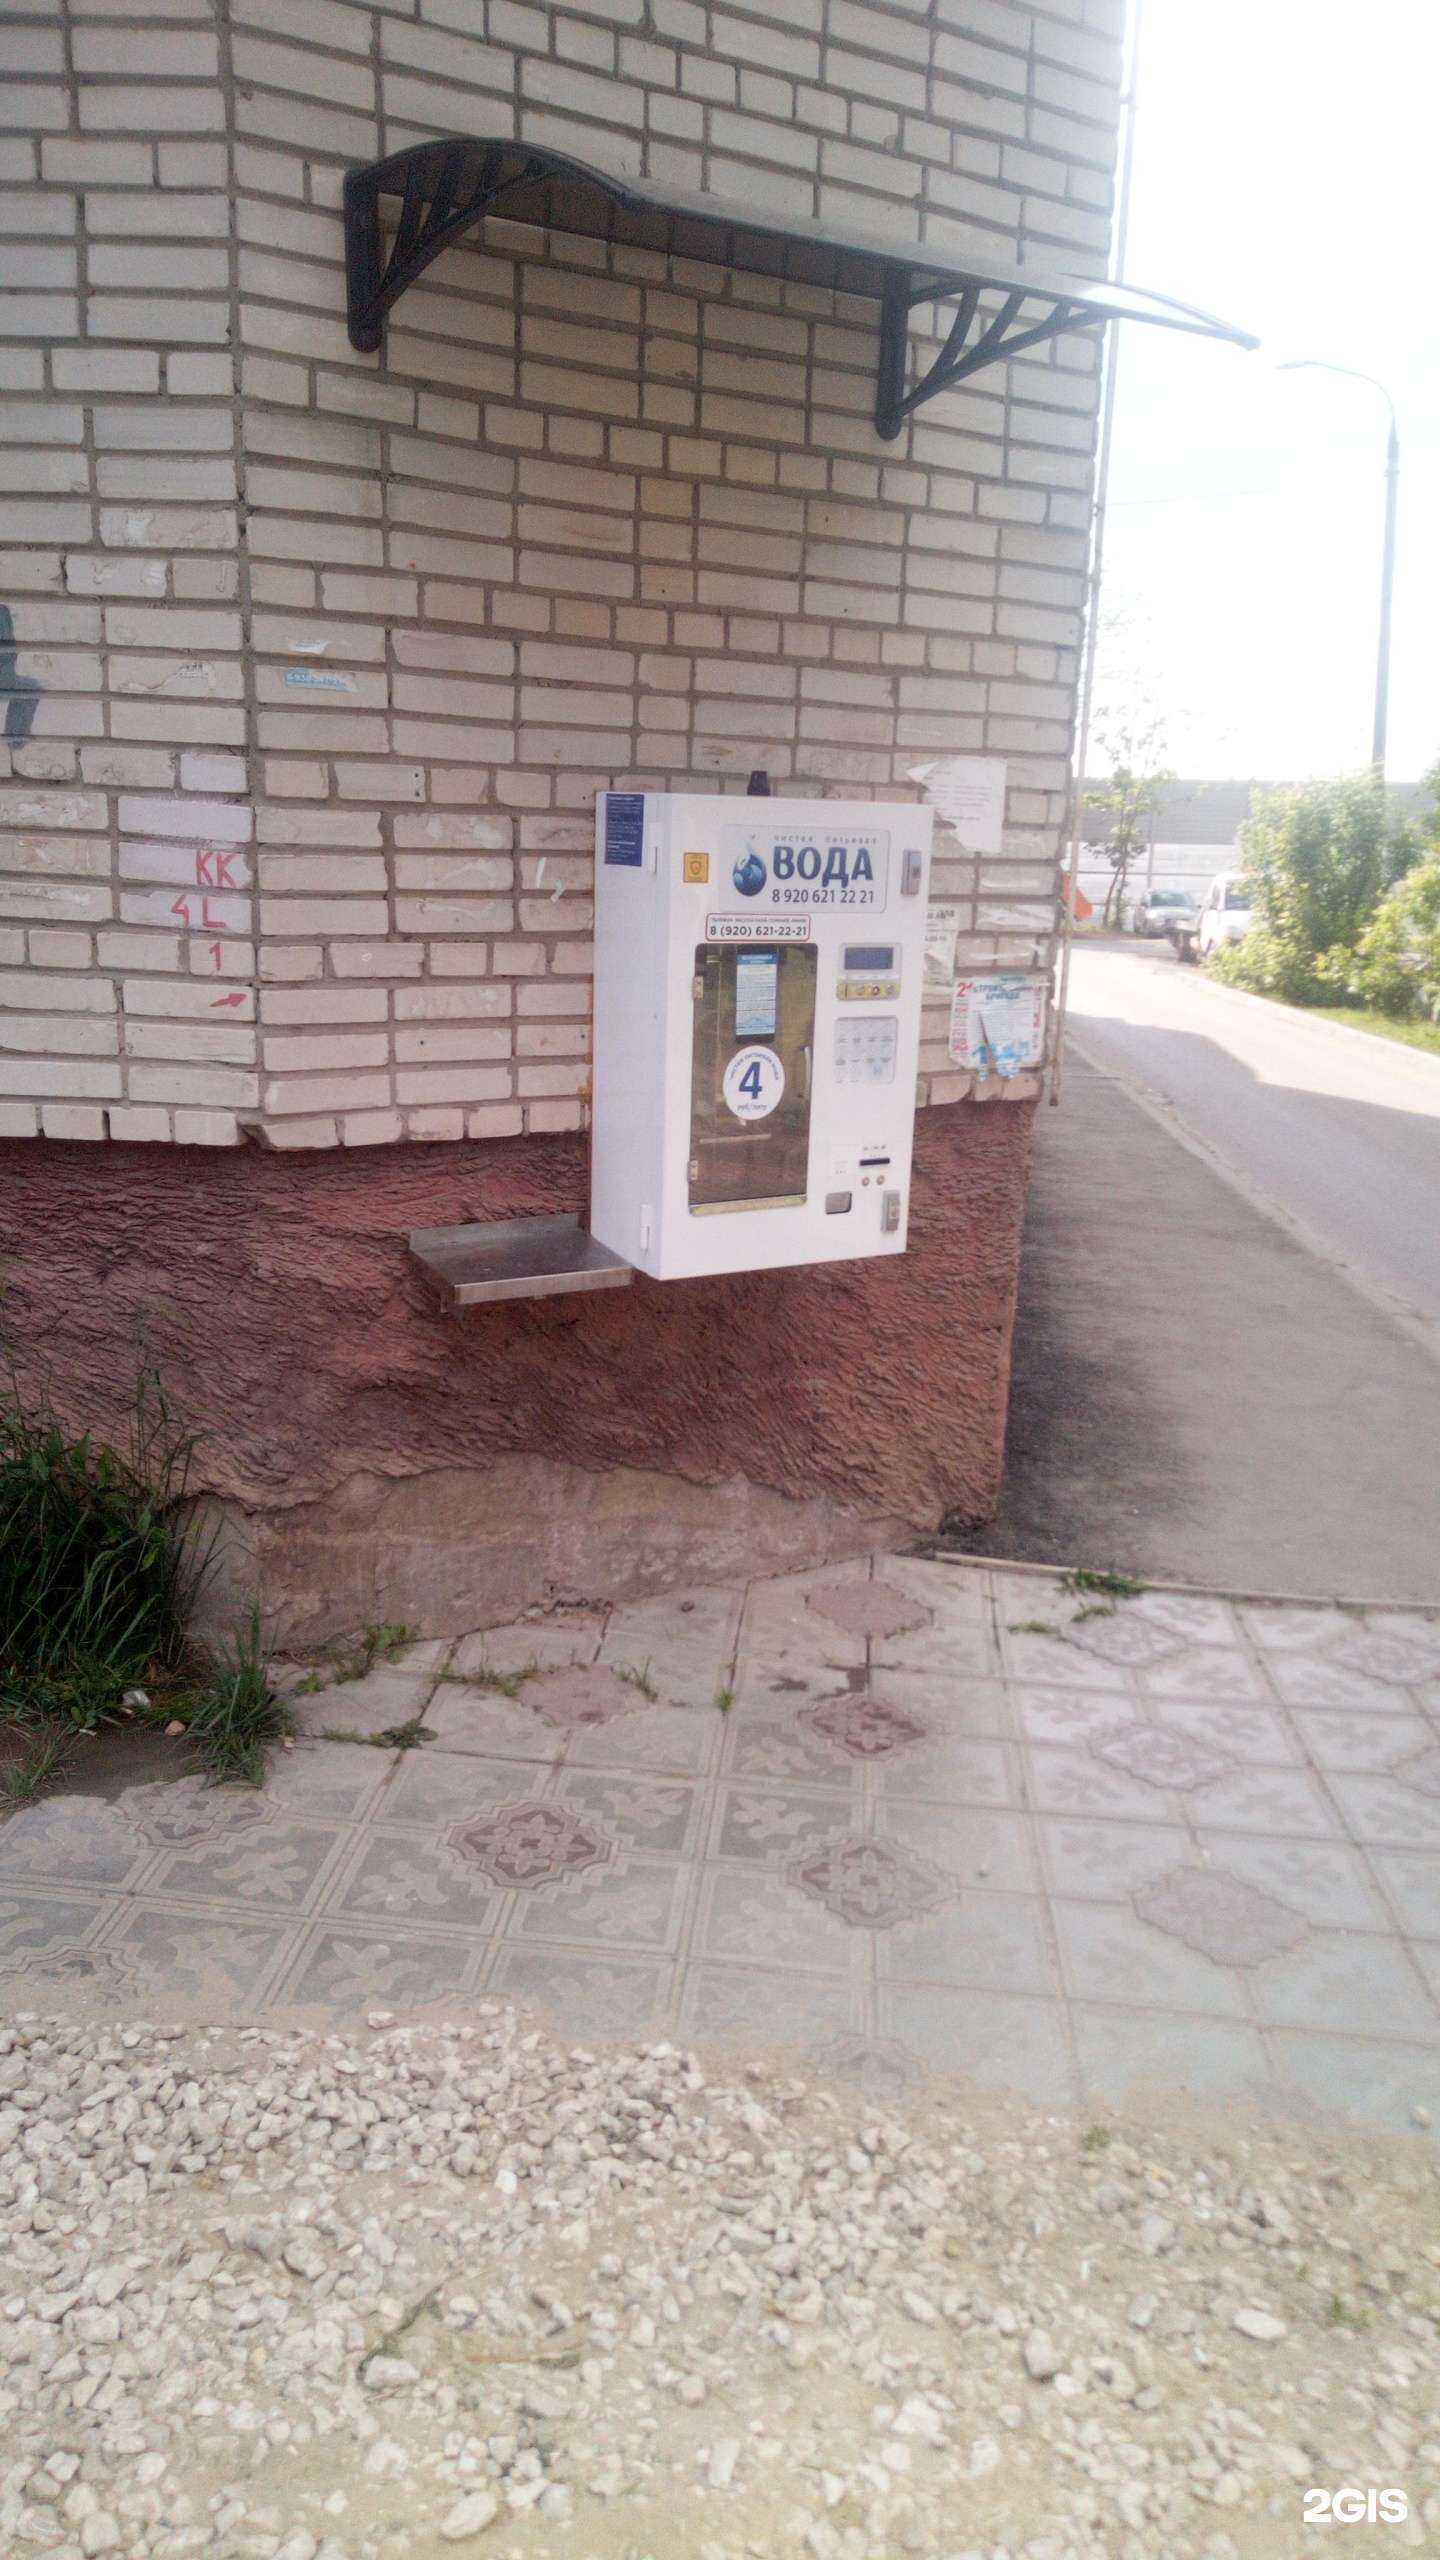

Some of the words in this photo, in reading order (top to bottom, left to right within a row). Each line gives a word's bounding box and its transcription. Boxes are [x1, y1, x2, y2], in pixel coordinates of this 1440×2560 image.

[773, 846, 874, 888] ВОДА
[772, 889, 780, 903] 8
[784, 889, 809, 903] 920
[812, 889, 835, 903] 621
[840, 889, 856, 903] 22
[860, 889, 874, 903] 21
[710, 926, 717, 936] 8
[720, 926, 752, 937] (920)
[755, 926, 807, 936] 621-22-21
[738, 1061, 763, 1099] 4
